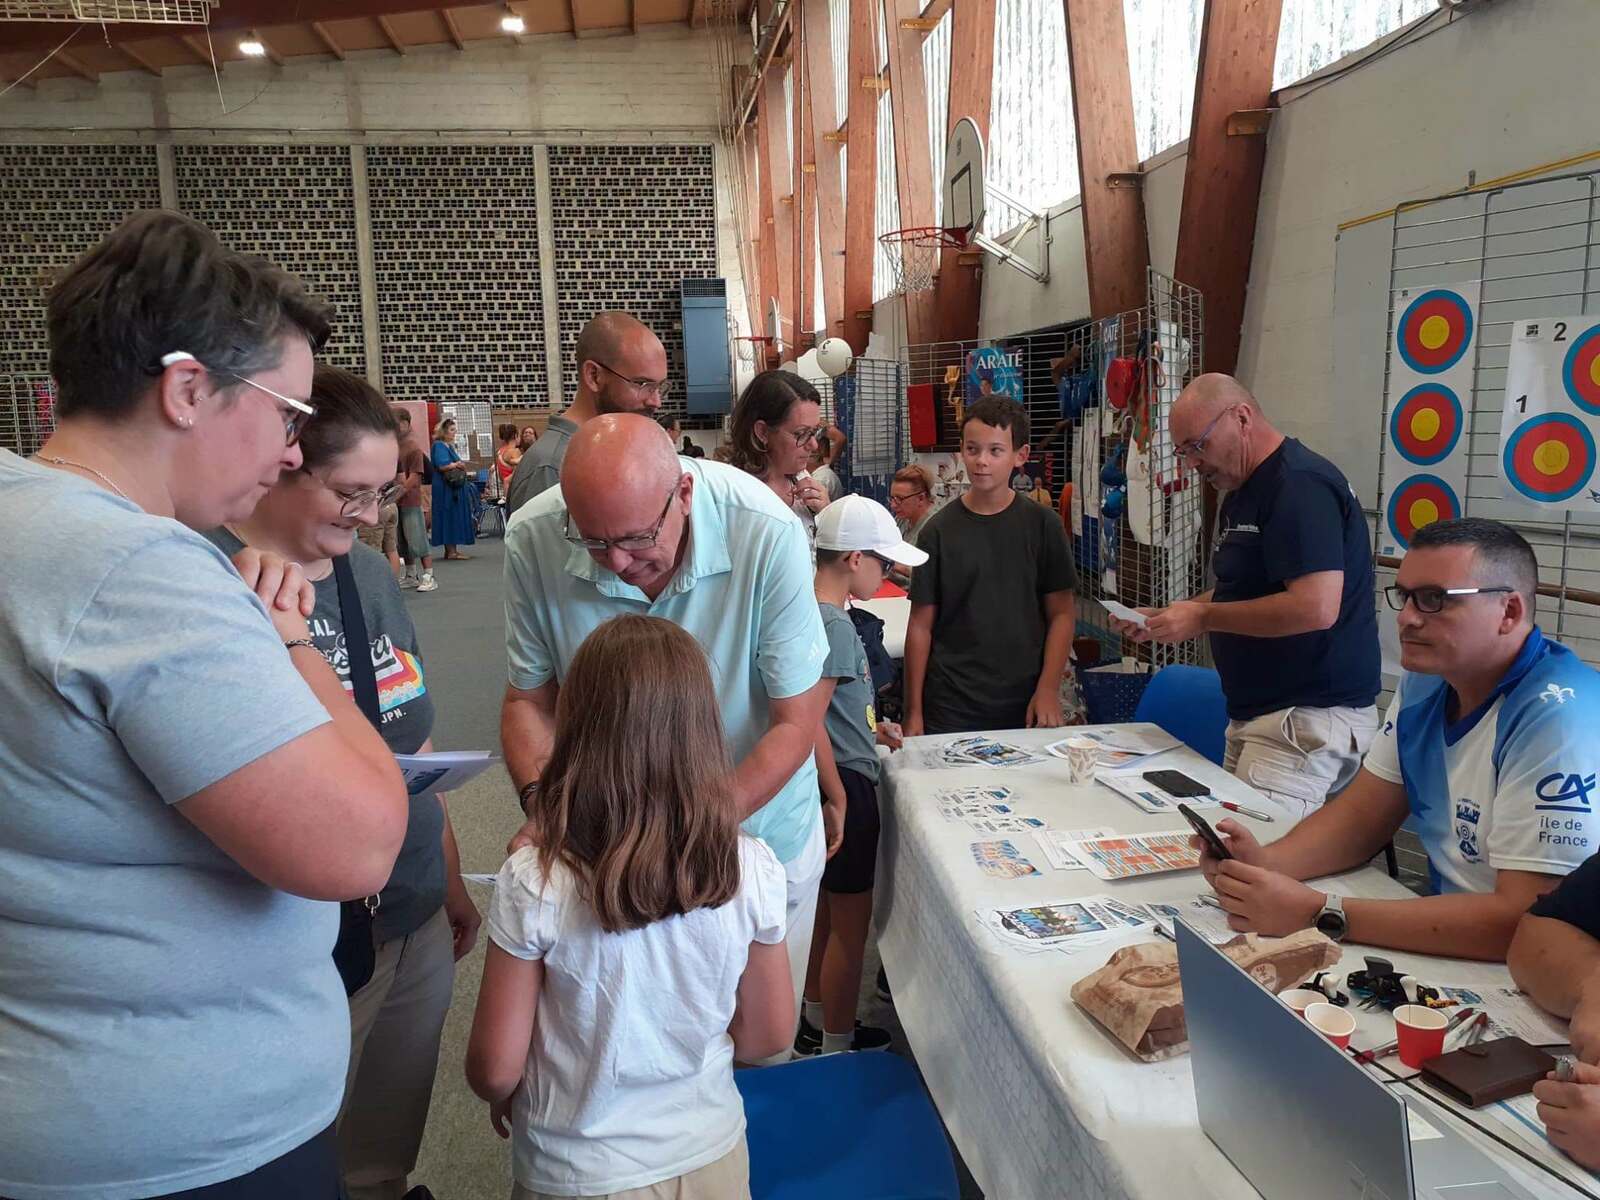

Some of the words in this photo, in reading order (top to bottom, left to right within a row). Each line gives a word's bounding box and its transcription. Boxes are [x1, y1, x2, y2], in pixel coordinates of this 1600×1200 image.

[1553, 322, 1567, 342] 2
[1515, 394, 1528, 413] 1
[1564, 818, 1583, 831] de
[1538, 831, 1588, 847] France
